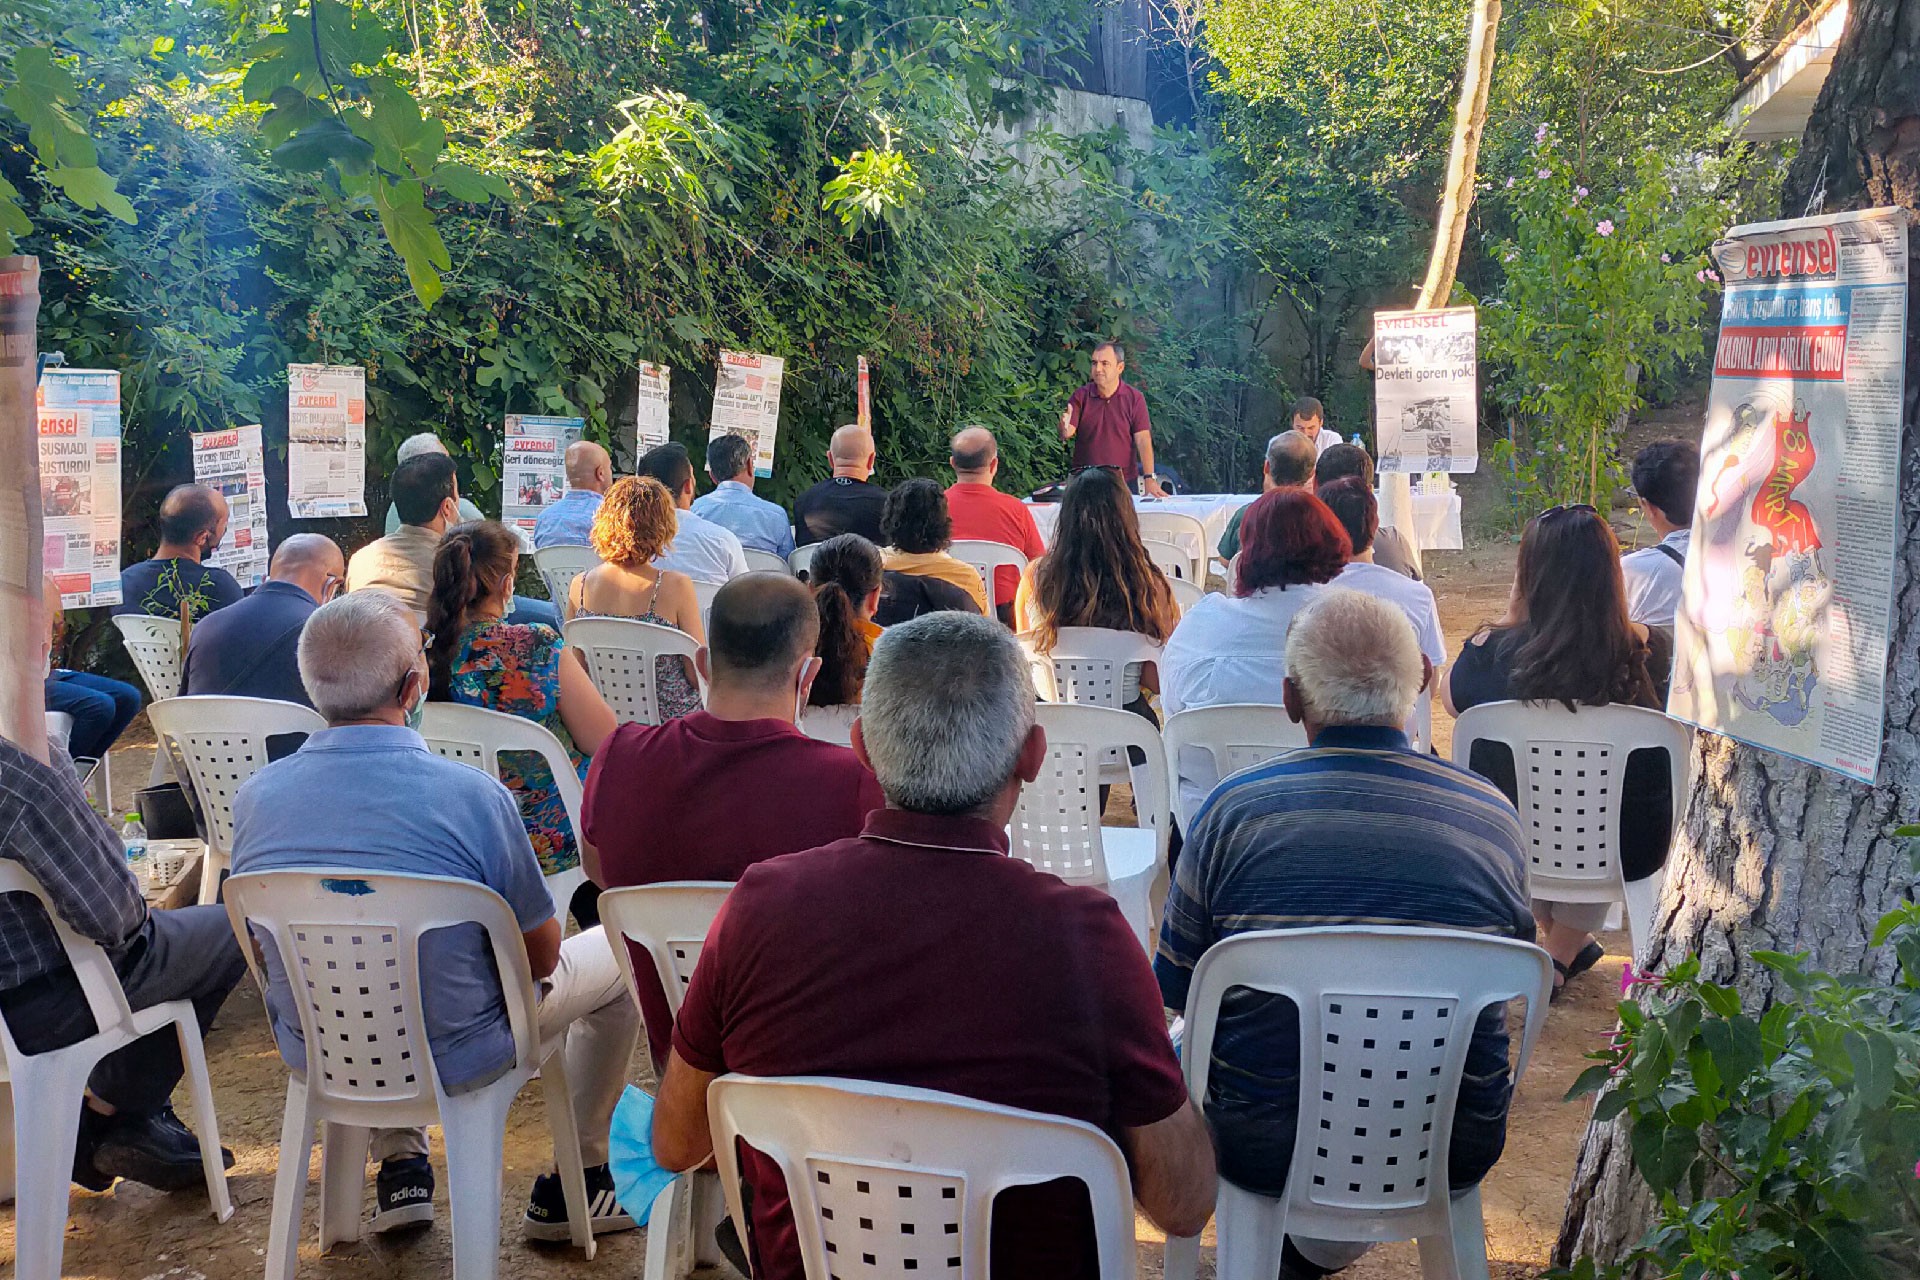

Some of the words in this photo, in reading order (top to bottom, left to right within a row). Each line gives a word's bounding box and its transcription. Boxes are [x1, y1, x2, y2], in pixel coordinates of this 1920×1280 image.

[1746, 227, 1836, 278] evrensel
[1787, 300, 1798, 318] ve
[1800, 295, 1821, 320] barış
[1376, 315, 1449, 331] EVRENSEL
[1718, 337, 1778, 370] KADINLARIN
[1778, 331, 1812, 371] BİRLİK
[1814, 330, 1845, 372] GÜNÜ
[1376, 366, 1413, 380] Devleti
[1416, 366, 1448, 382] gören
[1451, 363, 1475, 381] yok!
[298, 392, 337, 408] evrensel
[38, 411, 78, 436] ensel
[40, 442, 87, 456] SUSMADI
[202, 430, 239, 449] evrensel
[514, 438, 555, 451] evrensel
[1783, 429, 1807, 453] 8
[505, 453, 521, 464] Geri
[523, 455, 565, 468] döneceğiz
[1764, 455, 1801, 527] MART
[390, 1185, 428, 1202] adidas
